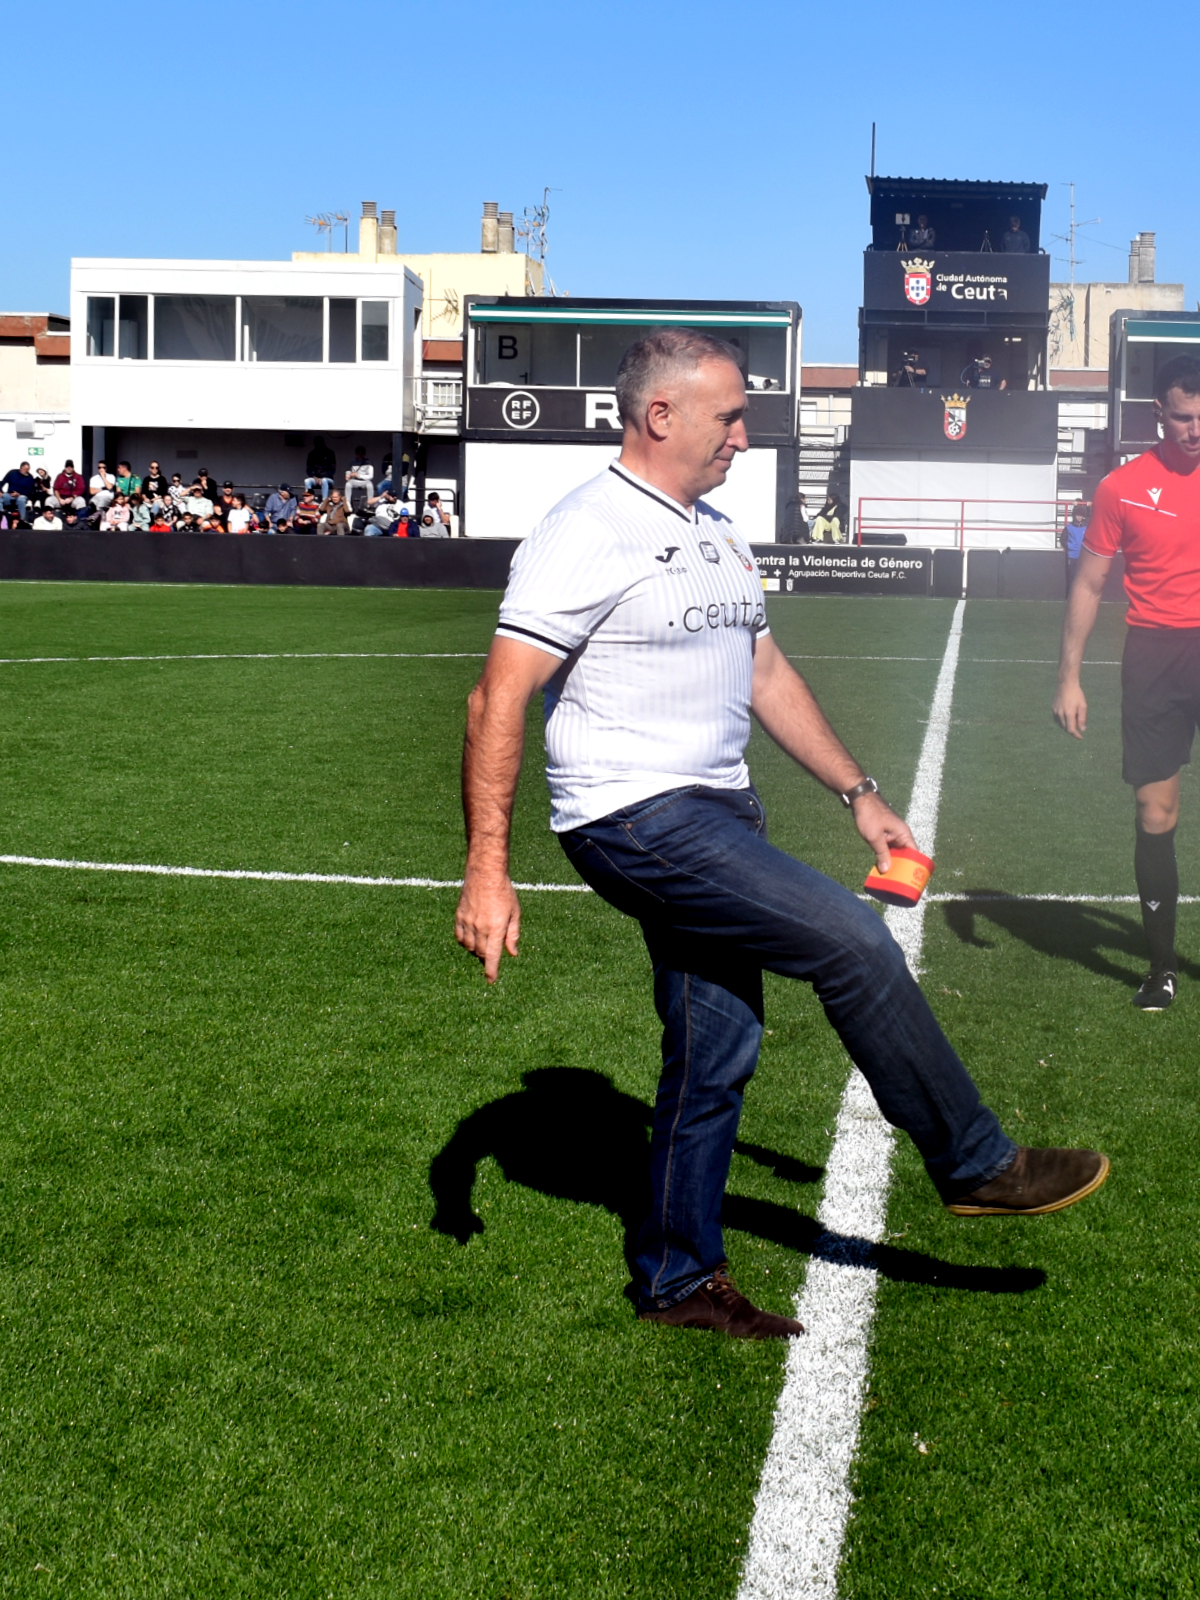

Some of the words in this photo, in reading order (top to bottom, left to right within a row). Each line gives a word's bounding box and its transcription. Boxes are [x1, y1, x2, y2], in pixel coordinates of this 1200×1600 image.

[936, 274, 964, 282] Ciudad
[965, 275, 1008, 283] Autónoma
[936, 283, 947, 291] de
[951, 283, 1008, 300] Ceuta
[498, 335, 518, 360] B
[585, 393, 624, 429] R
[755, 555, 786, 566] ontra
[789, 555, 800, 566] la
[802, 555, 857, 567] Violencia
[860, 557, 875, 568] de
[878, 557, 923, 569] Género
[788, 569, 829, 578] Agrupación
[831, 570, 866, 579] Deportiva
[867, 571, 890, 579] Ceuta
[891, 571, 907, 579] F.C.
